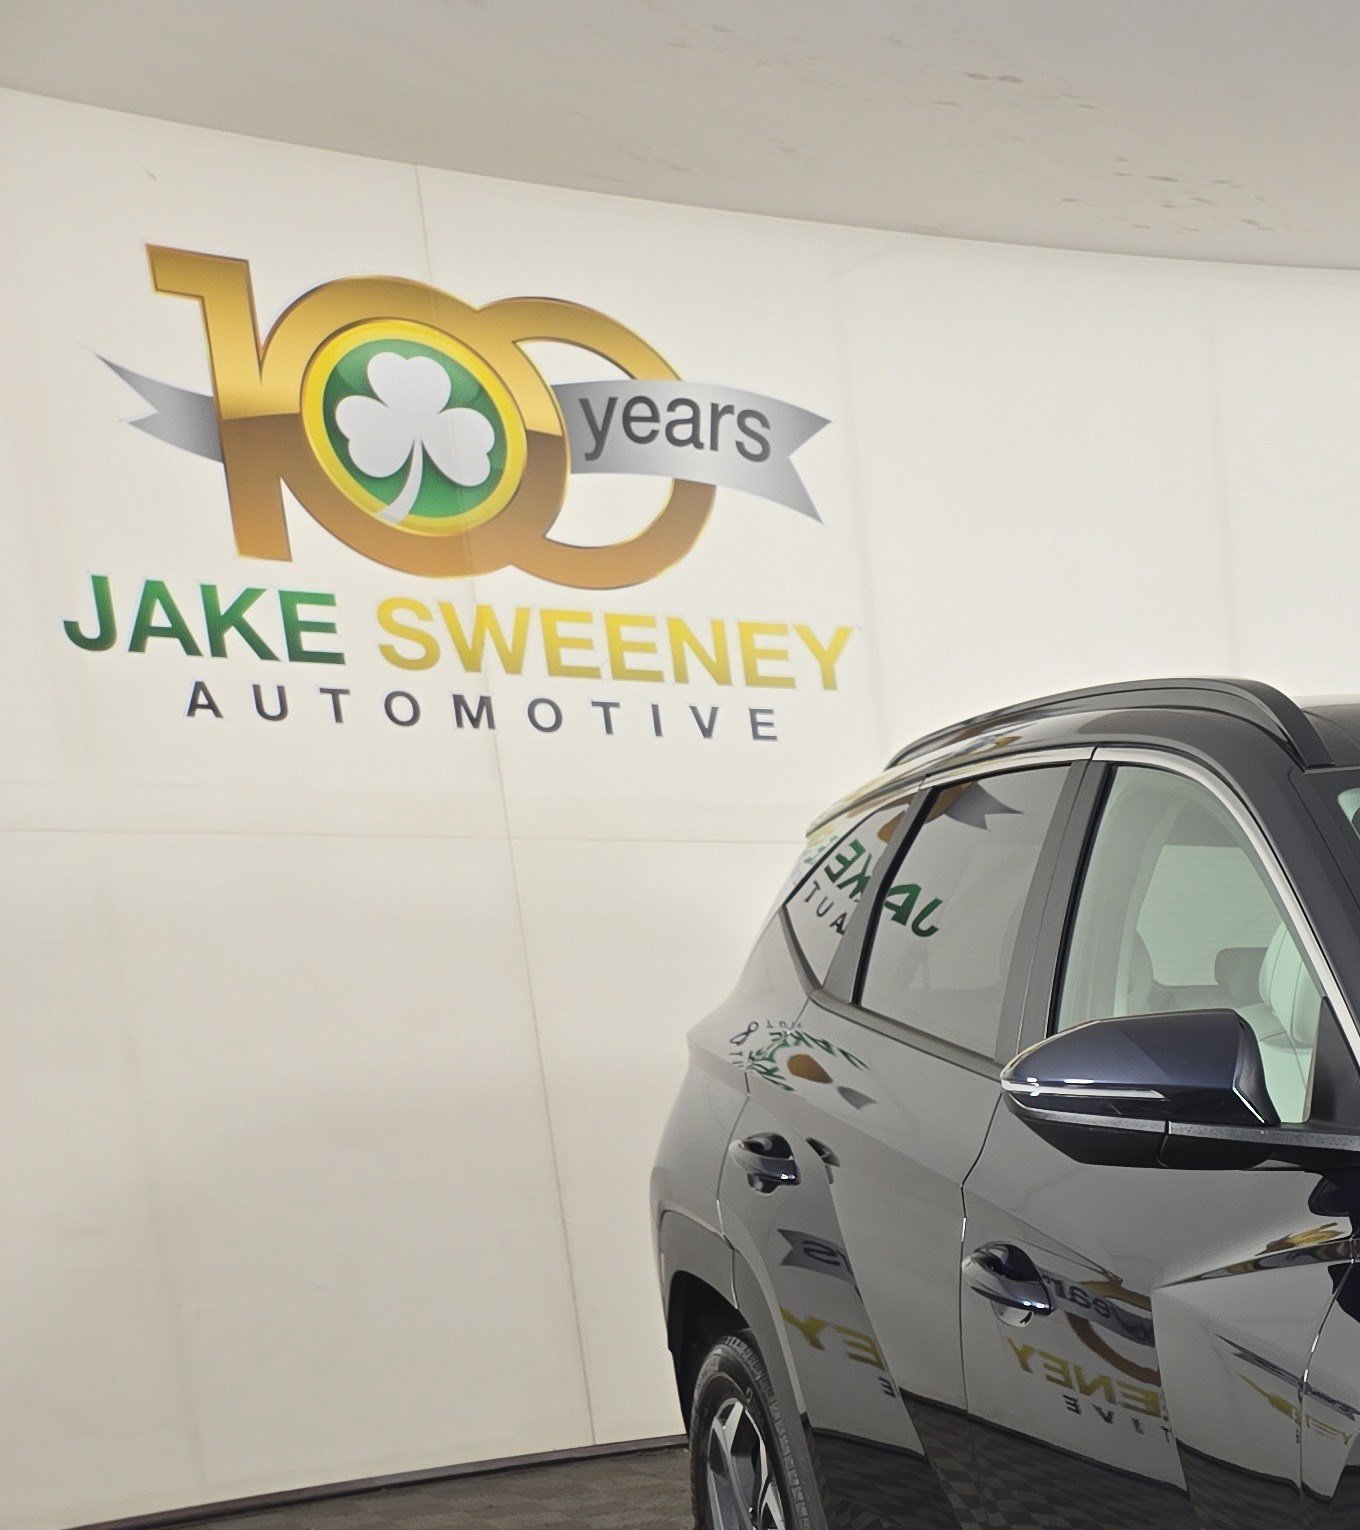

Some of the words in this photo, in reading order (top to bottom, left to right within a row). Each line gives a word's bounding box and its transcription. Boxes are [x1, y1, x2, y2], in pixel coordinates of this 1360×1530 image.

[146, 244, 717, 589] 100
[578, 396, 773, 463] years
[63, 574, 346, 666] JAKE
[378, 596, 854, 691] SWEENEY
[186, 681, 779, 741] AUTOMOTIVE
